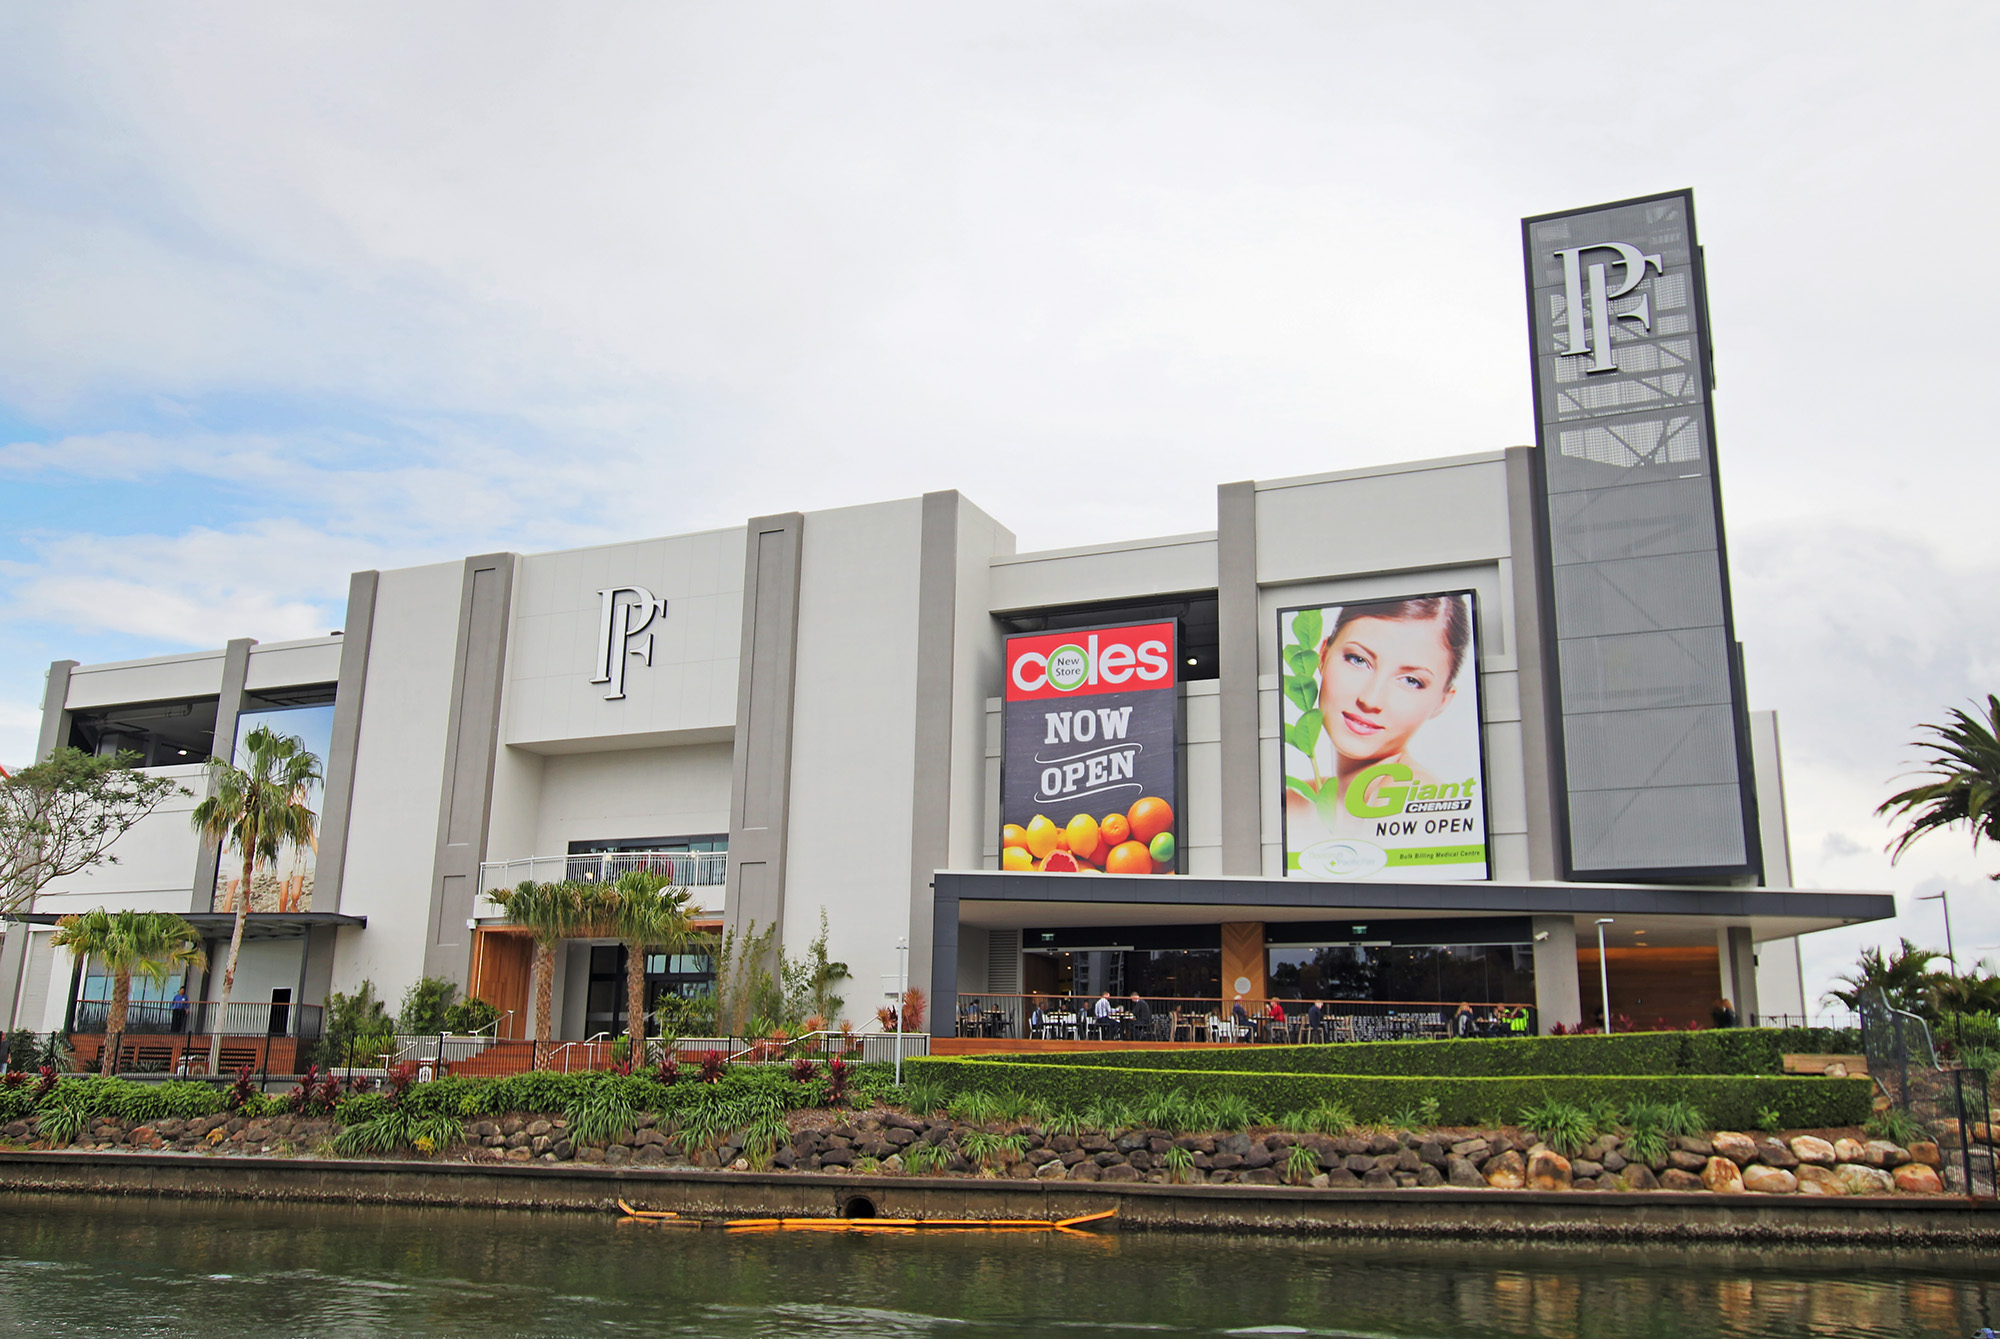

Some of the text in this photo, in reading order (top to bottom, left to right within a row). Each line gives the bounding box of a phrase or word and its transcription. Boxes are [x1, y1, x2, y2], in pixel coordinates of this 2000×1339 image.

[1012, 634, 1169, 692] coles
[1055, 667, 1081, 677] Store
[1057, 657, 1080, 667] New
[1044, 706, 1133, 744] NOW
[1041, 750, 1136, 796] OPEN
[1344, 763, 1477, 819] Giant
[1408, 800, 1470, 813] CHEMIST
[1376, 817, 1475, 837] NOW OPEN
[1414, 852, 1434, 860] Billing
[1435, 851, 1459, 859] Medical
